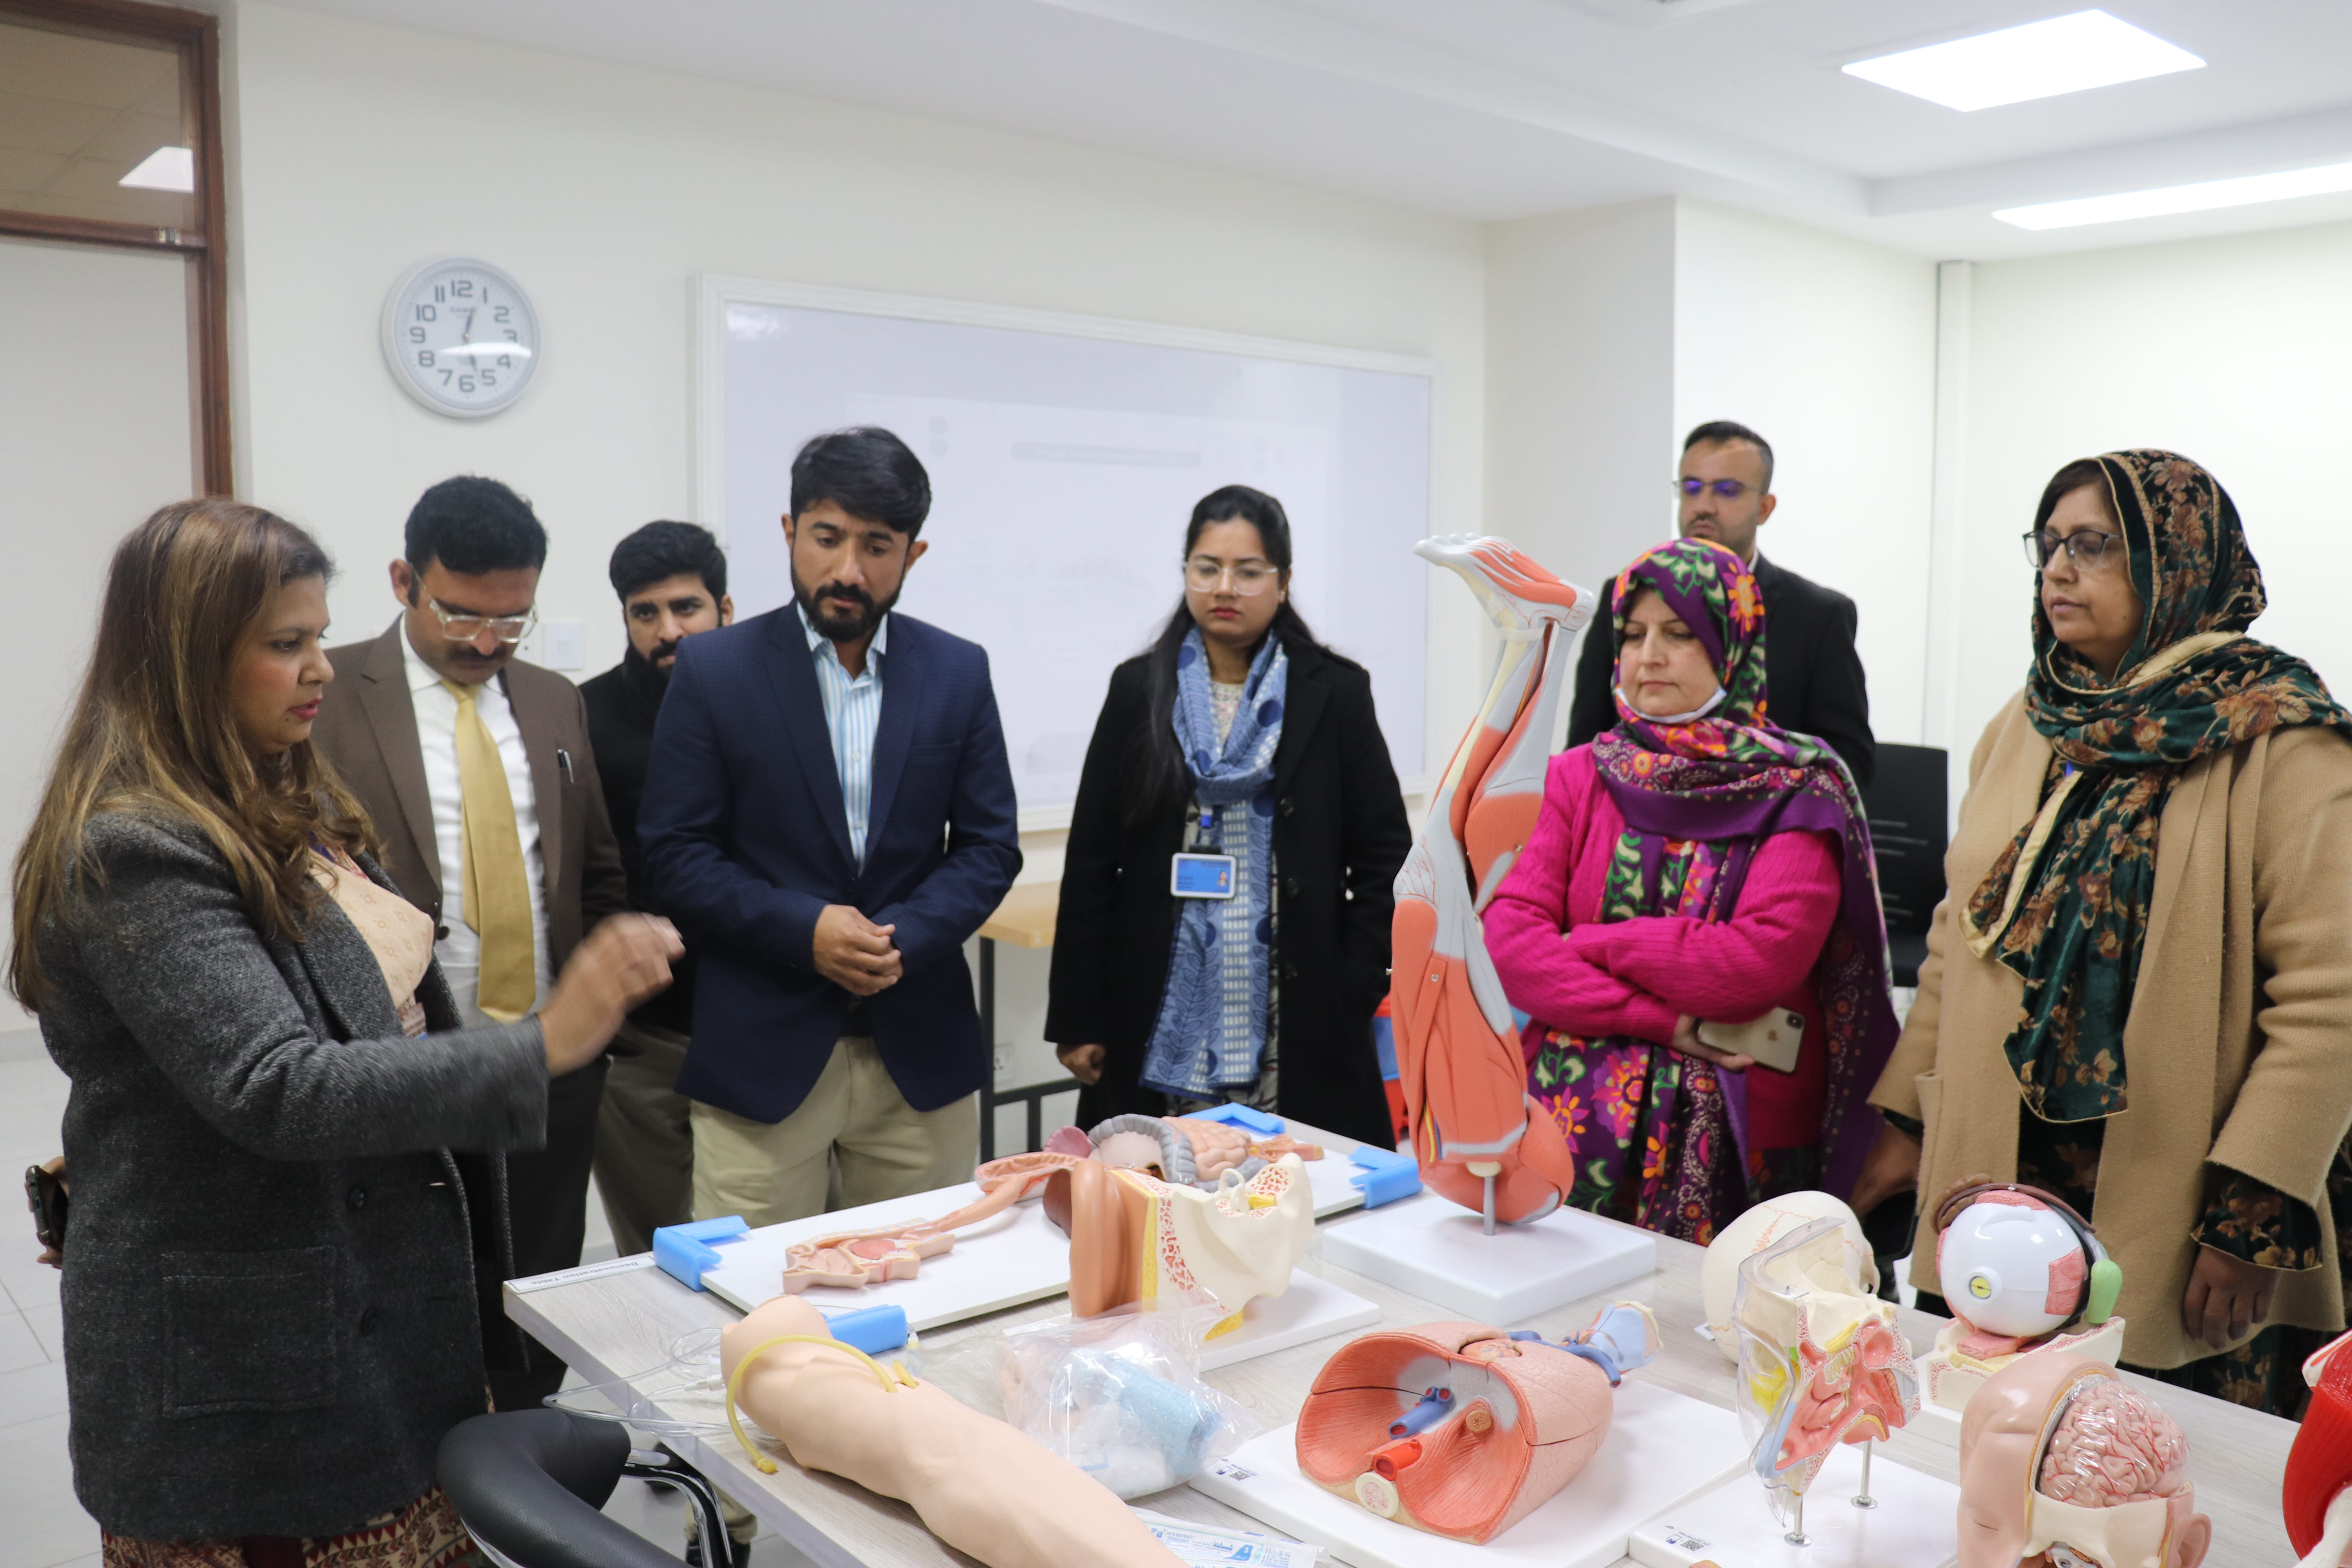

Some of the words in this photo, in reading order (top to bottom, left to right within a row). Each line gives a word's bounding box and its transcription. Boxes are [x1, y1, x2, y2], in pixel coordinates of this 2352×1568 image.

[434, 285, 445, 303] 11
[450, 279, 473, 298] 12
[483, 287, 488, 303] 1
[416, 304, 436, 322] 10
[494, 305, 510, 323] 2
[409, 326, 426, 344] 9
[503, 329, 518, 342] 3
[418, 350, 435, 367] 8
[497, 354, 512, 369] 4
[437, 368, 453, 386] 7
[458, 374, 475, 392] 6
[481, 368, 497, 386] 5
[563, 1261, 639, 1278] Demonstration
